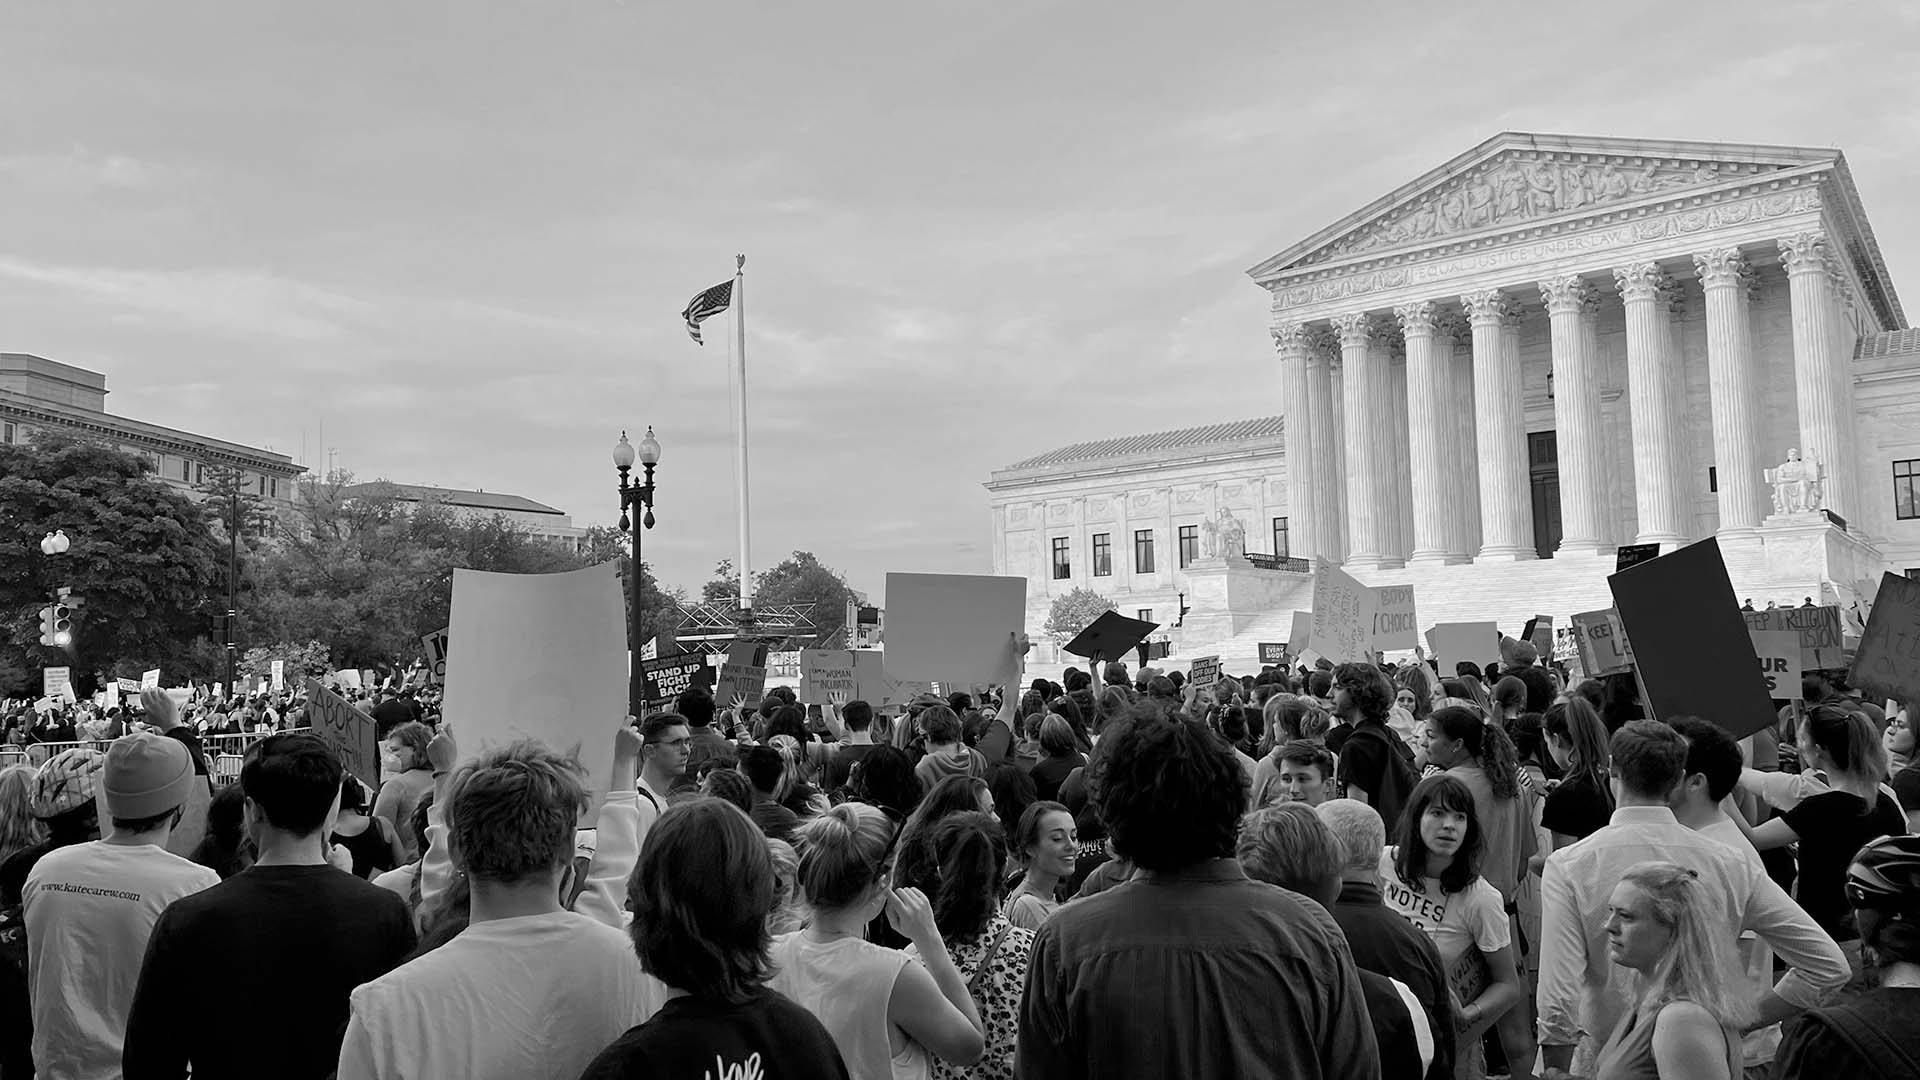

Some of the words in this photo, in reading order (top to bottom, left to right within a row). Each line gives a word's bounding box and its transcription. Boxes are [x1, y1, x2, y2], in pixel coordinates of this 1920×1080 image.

[1419, 261, 1466, 279] EQUAL
[1470, 249, 1529, 270] JUSTICE
[1535, 237, 1588, 256] UNDER
[1592, 229, 1624, 247] LAW
[1381, 588, 1412, 606] BODY
[1381, 612, 1414, 633] CHOICE
[1745, 612, 1770, 631] EEP
[1588, 623, 1614, 640] KEE
[647, 667, 681, 681] STAND
[684, 664, 700, 674] UP
[826, 669, 851, 679] WOMAN
[1761, 658, 1788, 673] UR
[657, 674, 691, 688] FIGHT
[820, 679, 853, 689] INCUBATOR
[312, 687, 370, 745] ABORT
[40, 882, 141, 902] www.katecarew.com
[1390, 884, 1445, 923] VOTES
